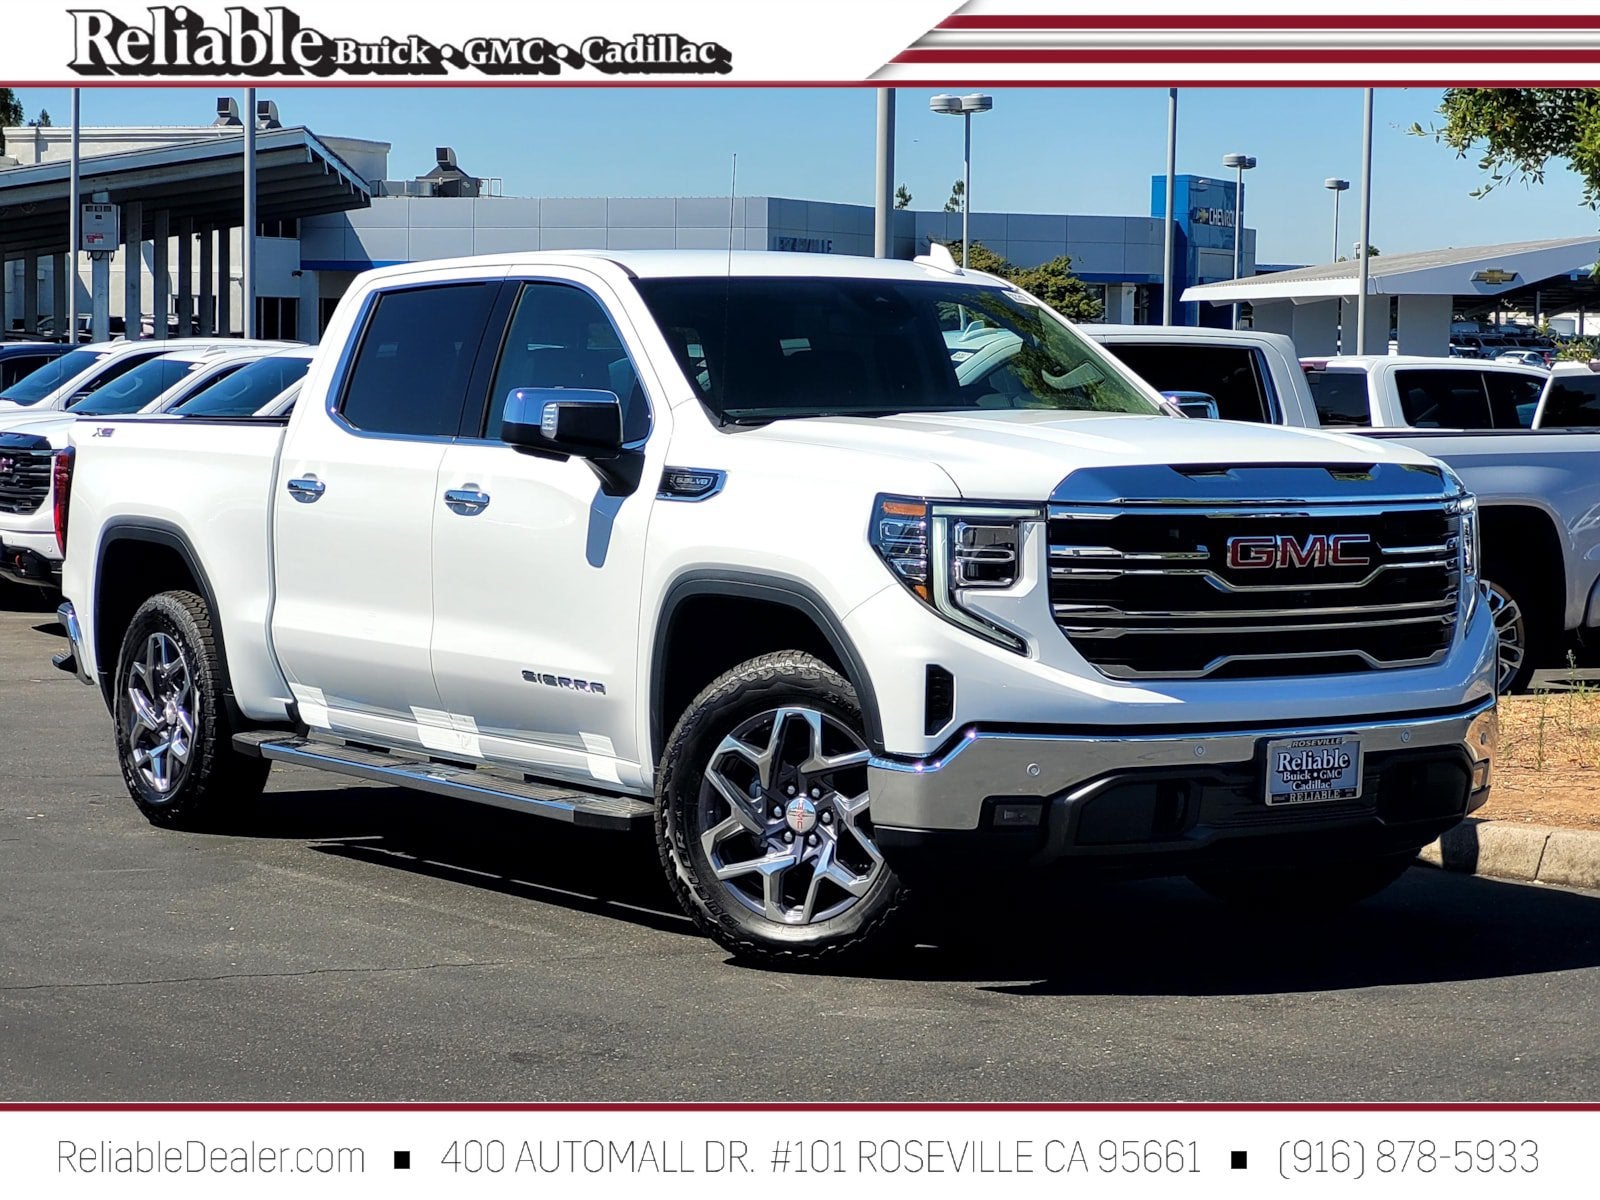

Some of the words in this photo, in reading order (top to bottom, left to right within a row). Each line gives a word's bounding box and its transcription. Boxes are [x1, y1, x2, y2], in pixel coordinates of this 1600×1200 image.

[1226, 533, 1371, 569] GMC
[521, 669, 607, 696] SIERRA
[1291, 737, 1343, 748] ROSEVILLE
[1276, 748, 1351, 772] Reliable
[1283, 769, 1311, 781] Buick
[1319, 768, 1342, 779] GMC
[1292, 780, 1331, 791] Cadillac
[1289, 790, 1341, 803] RELIABLE
